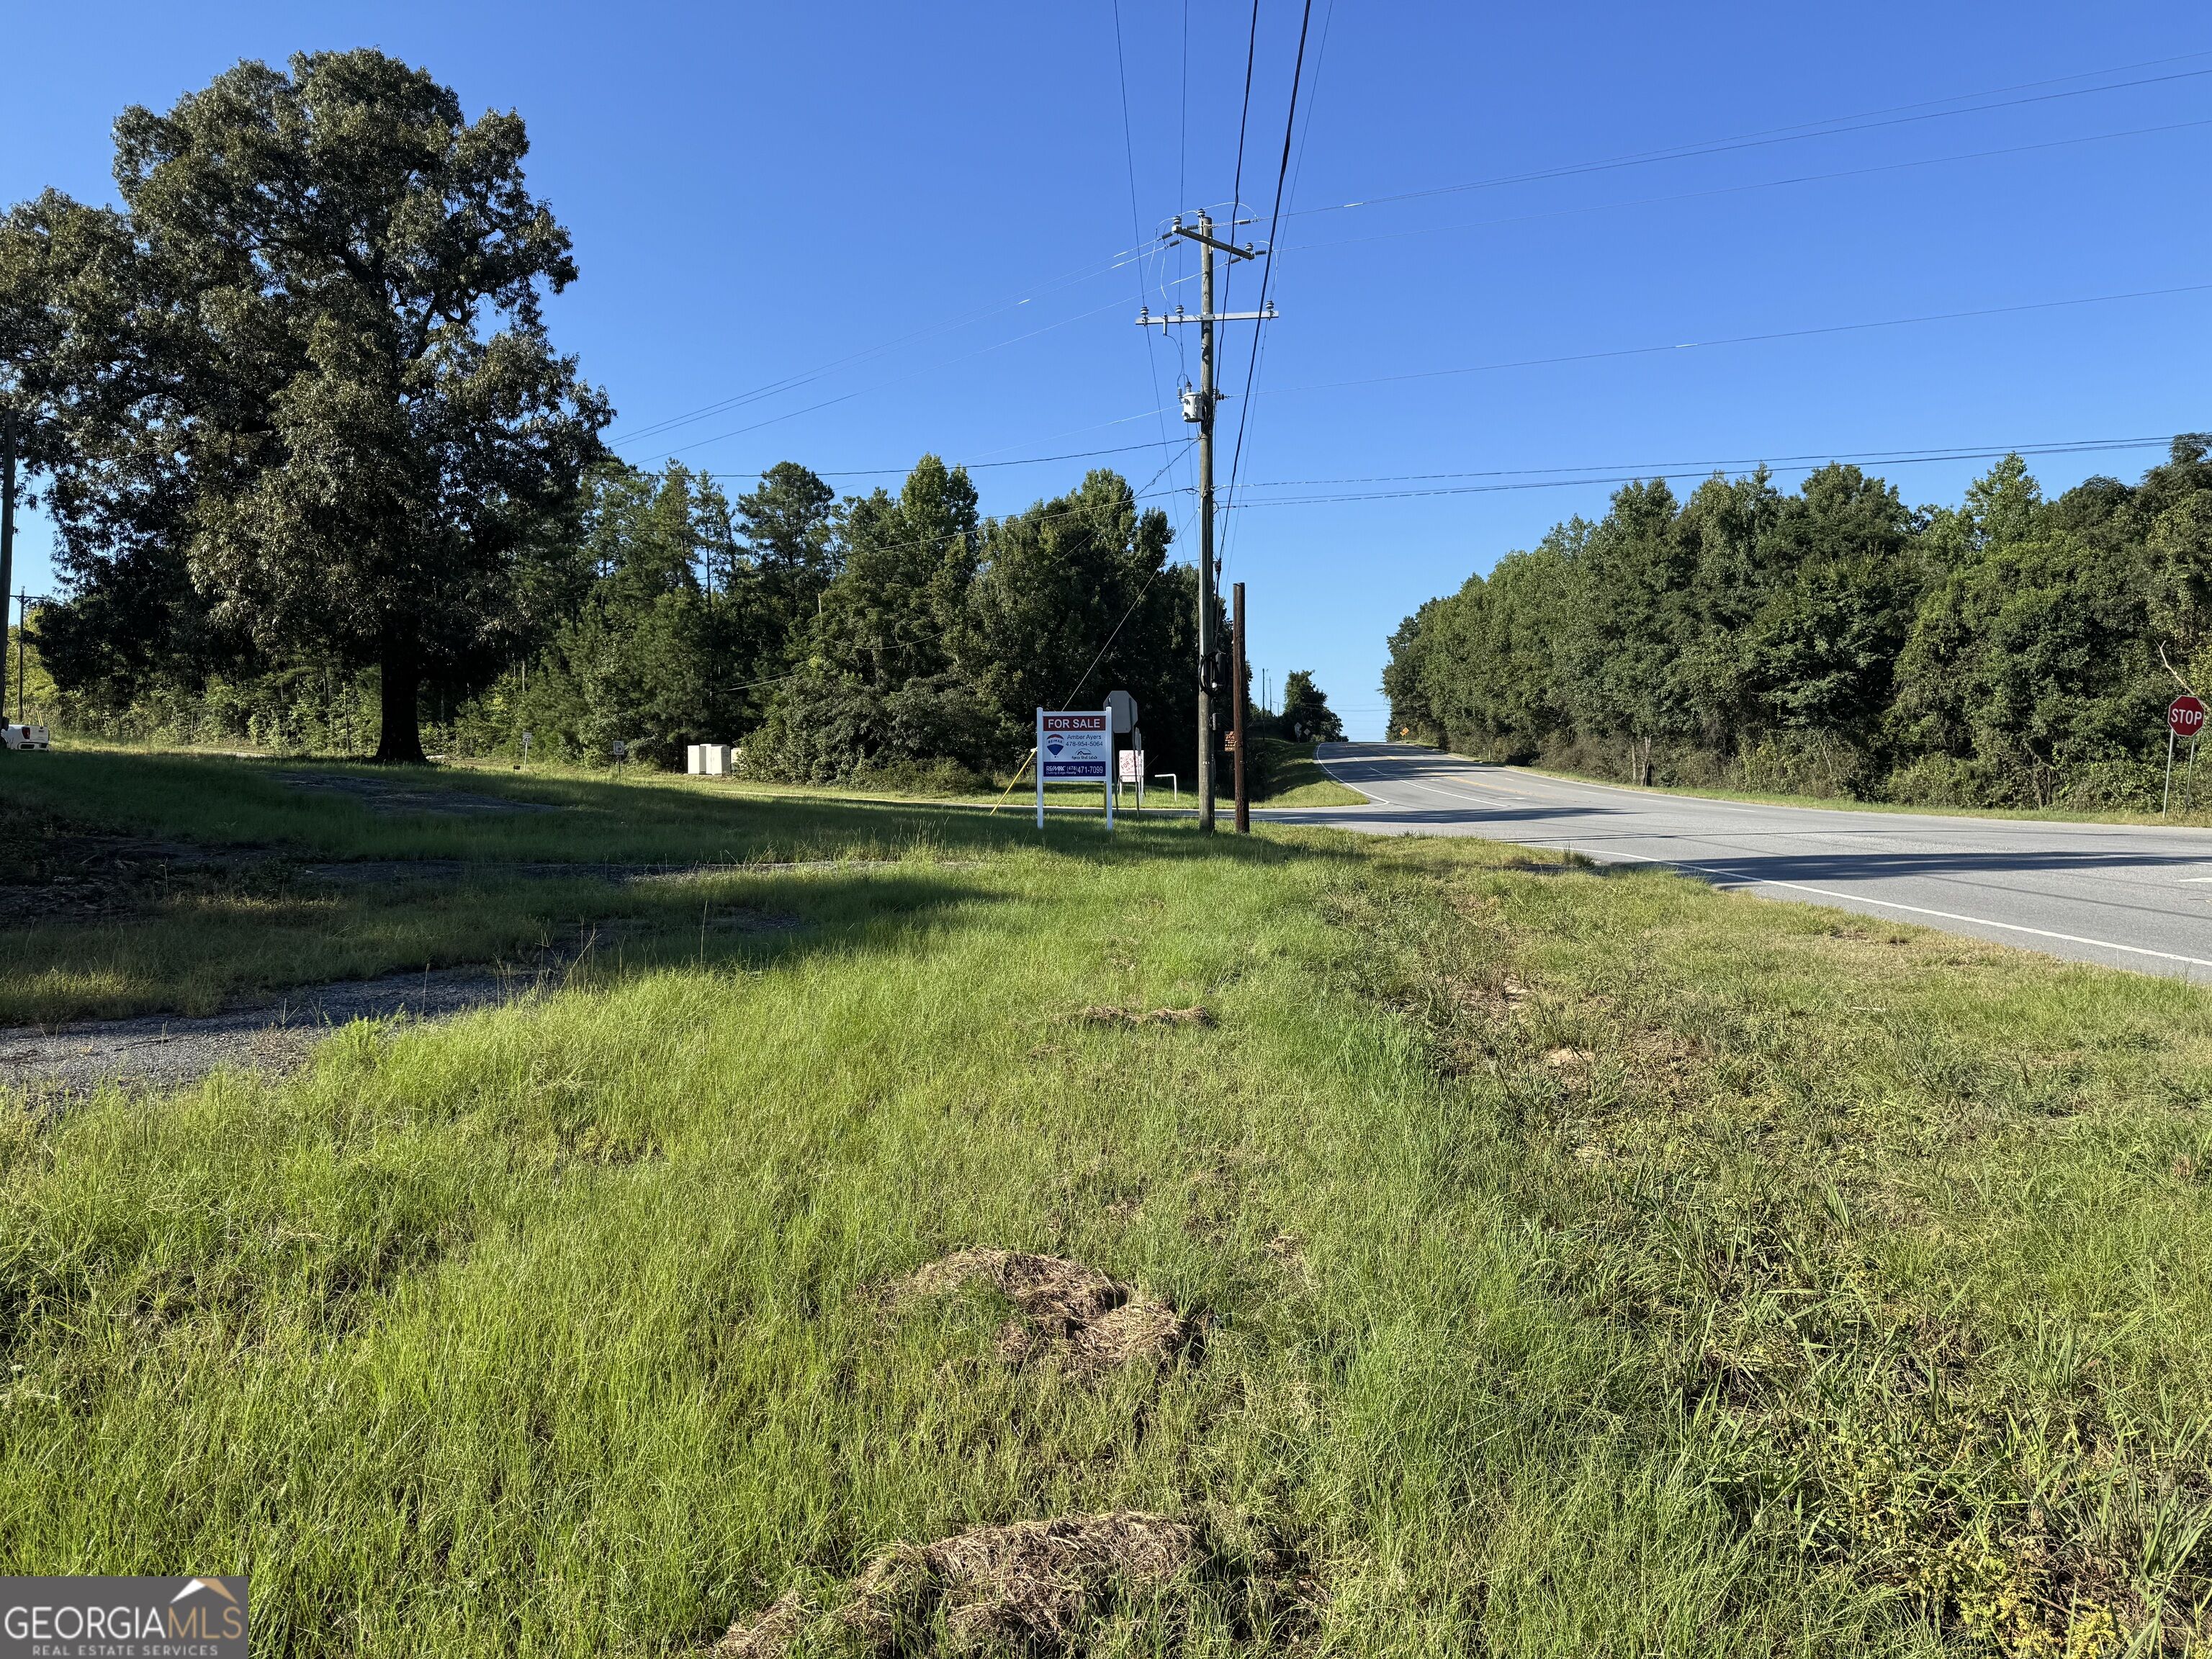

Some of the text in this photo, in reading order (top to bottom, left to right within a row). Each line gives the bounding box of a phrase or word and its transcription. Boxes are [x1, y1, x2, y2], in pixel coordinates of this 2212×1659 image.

[2171, 708, 2202, 725] STOP
[1048, 719, 1100, 729] FOR SALE
